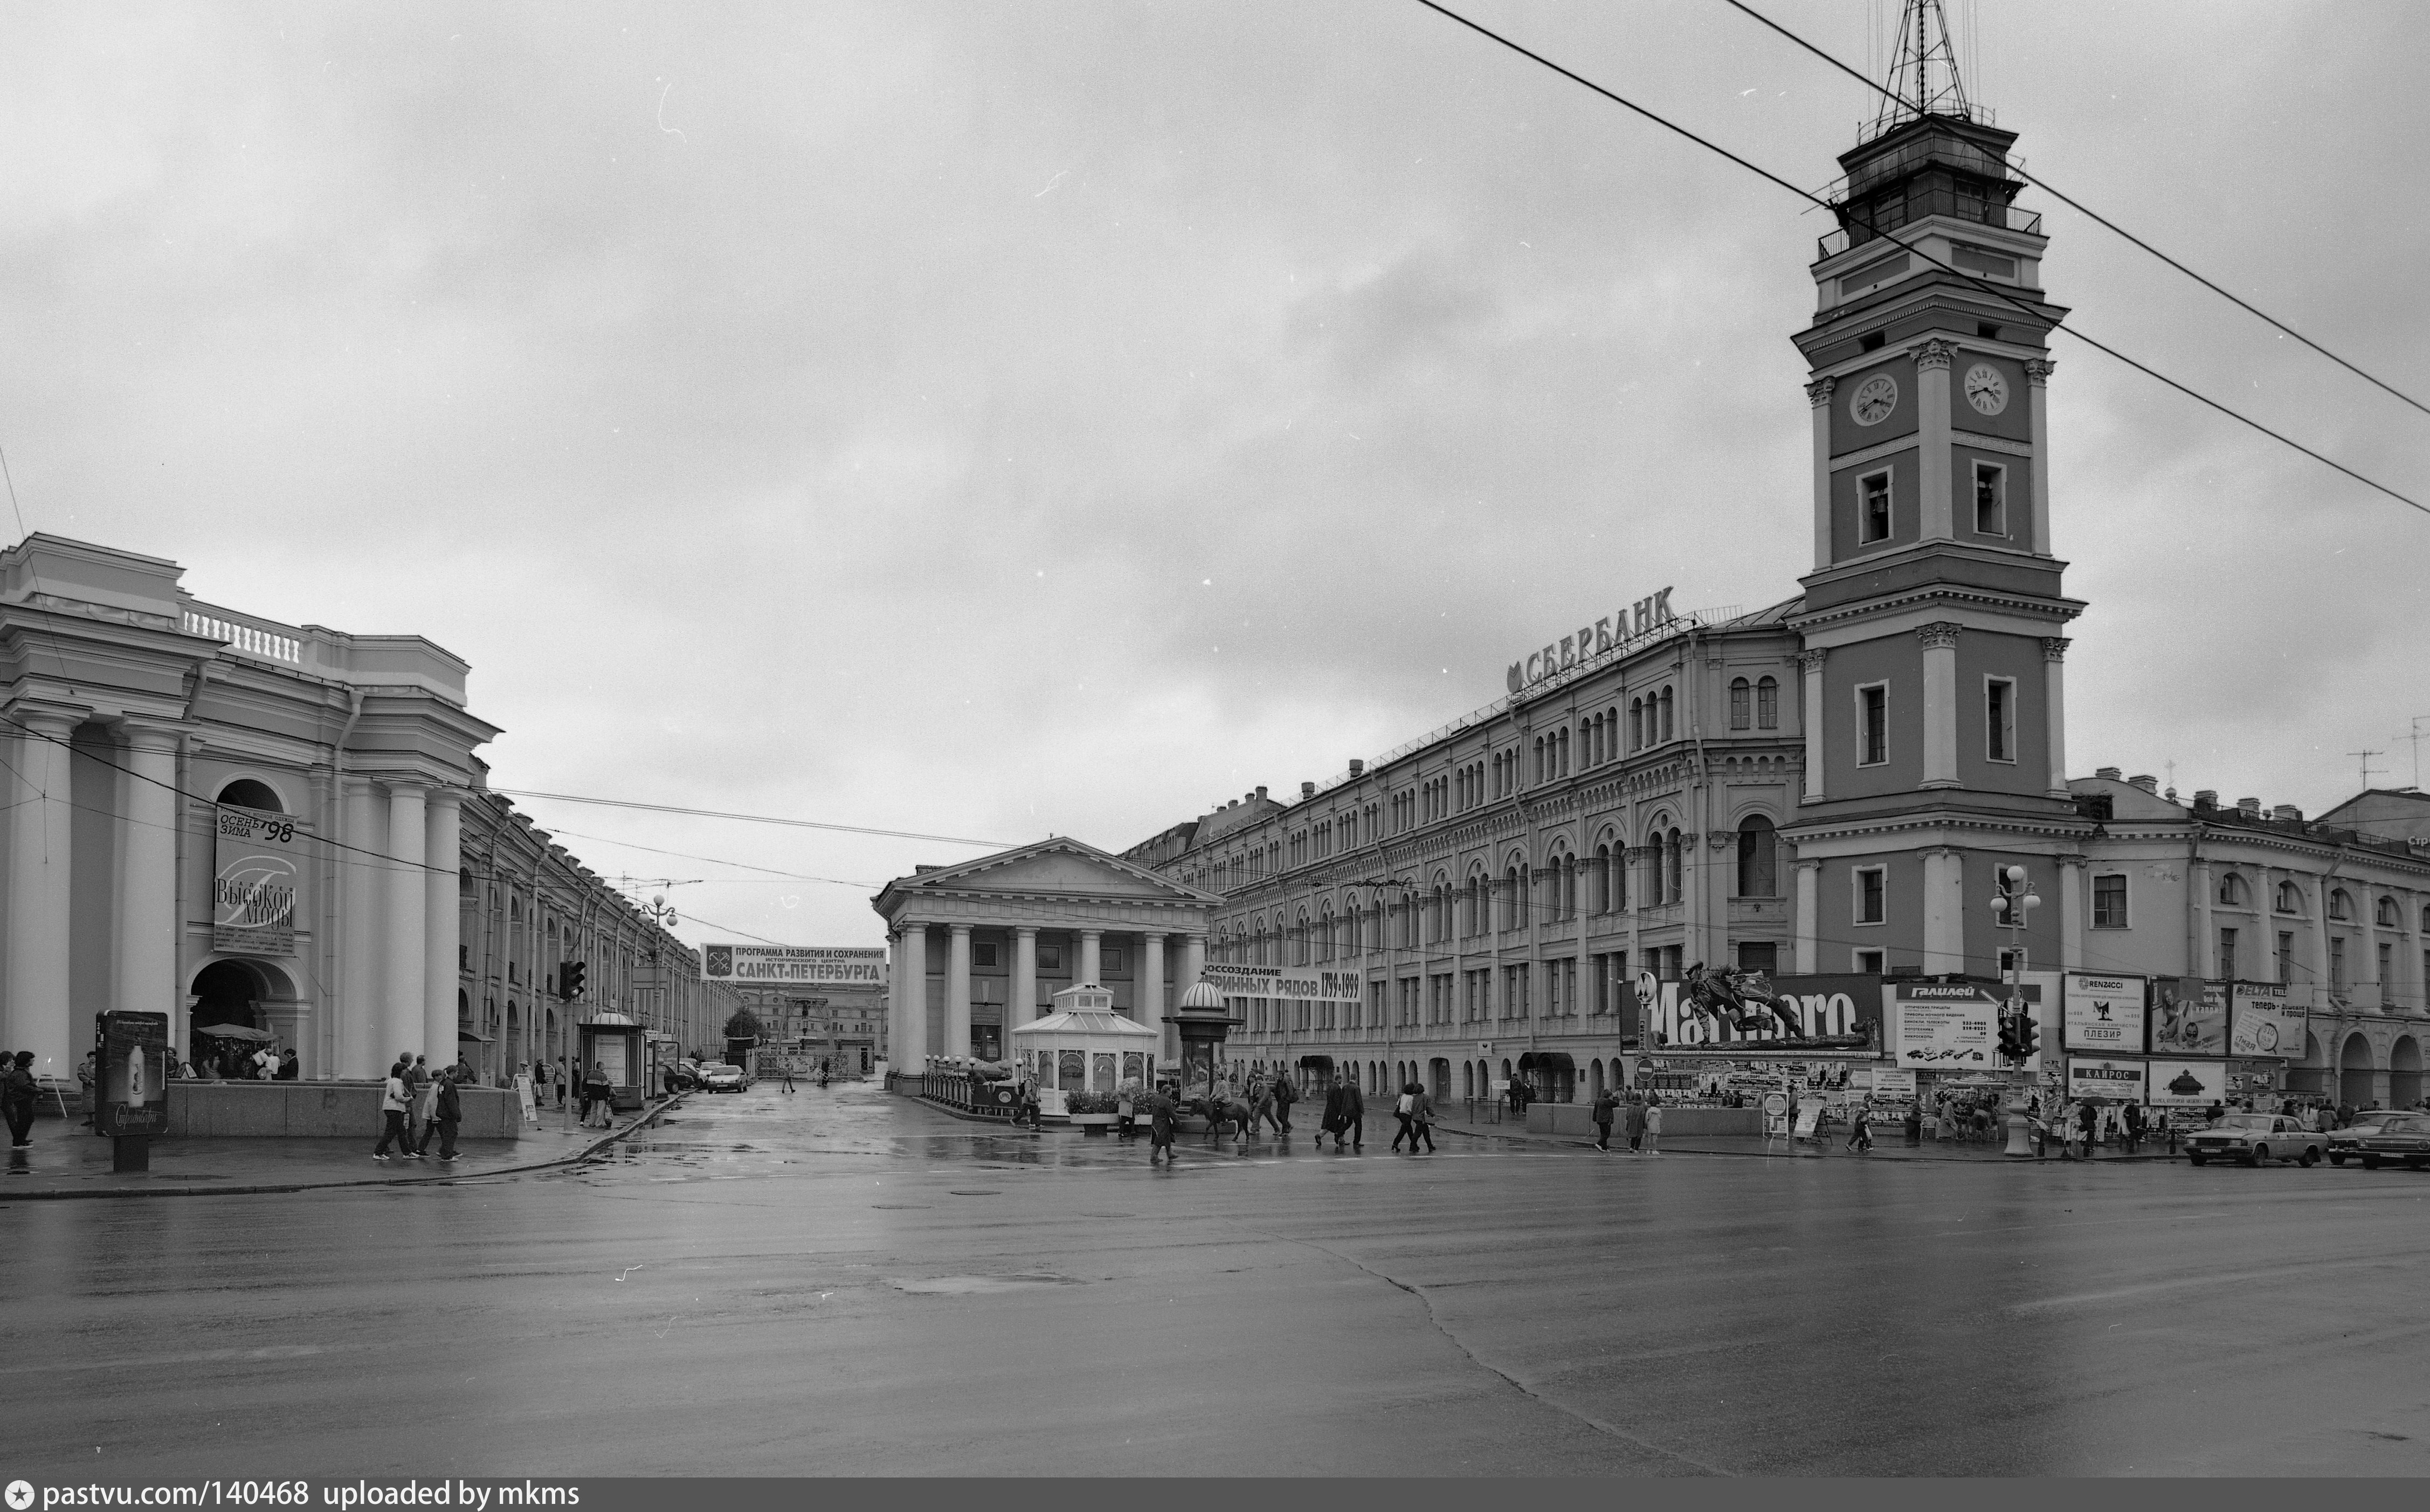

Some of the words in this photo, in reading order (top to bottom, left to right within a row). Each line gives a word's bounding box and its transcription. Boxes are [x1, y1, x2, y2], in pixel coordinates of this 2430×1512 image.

[1527, 586, 1674, 683] СБЕРБАНК
[220, 814, 260, 829] ОСЕНЬ
[220, 825, 251, 838] ЗИМА
[736, 948, 782, 957] ПРОГРАММА
[786, 949, 824, 958] РАЗВИТИЯ
[834, 950, 884, 959] СОХРАНЕНИЯ
[736, 962, 880, 980] САНКТ-ПЕТЕРБУРГА
[1276, 979, 1318, 998] РЯДОВ
[1321, 972, 1359, 998] 1799-1999
[2089, 981, 2123, 989] RENZACCI
[2252, 1001, 2276, 1011] теперь
[2286, 1010, 2305, 1018] проще
[2084, 1030, 2121, 1038] ПЛЕЗИР
